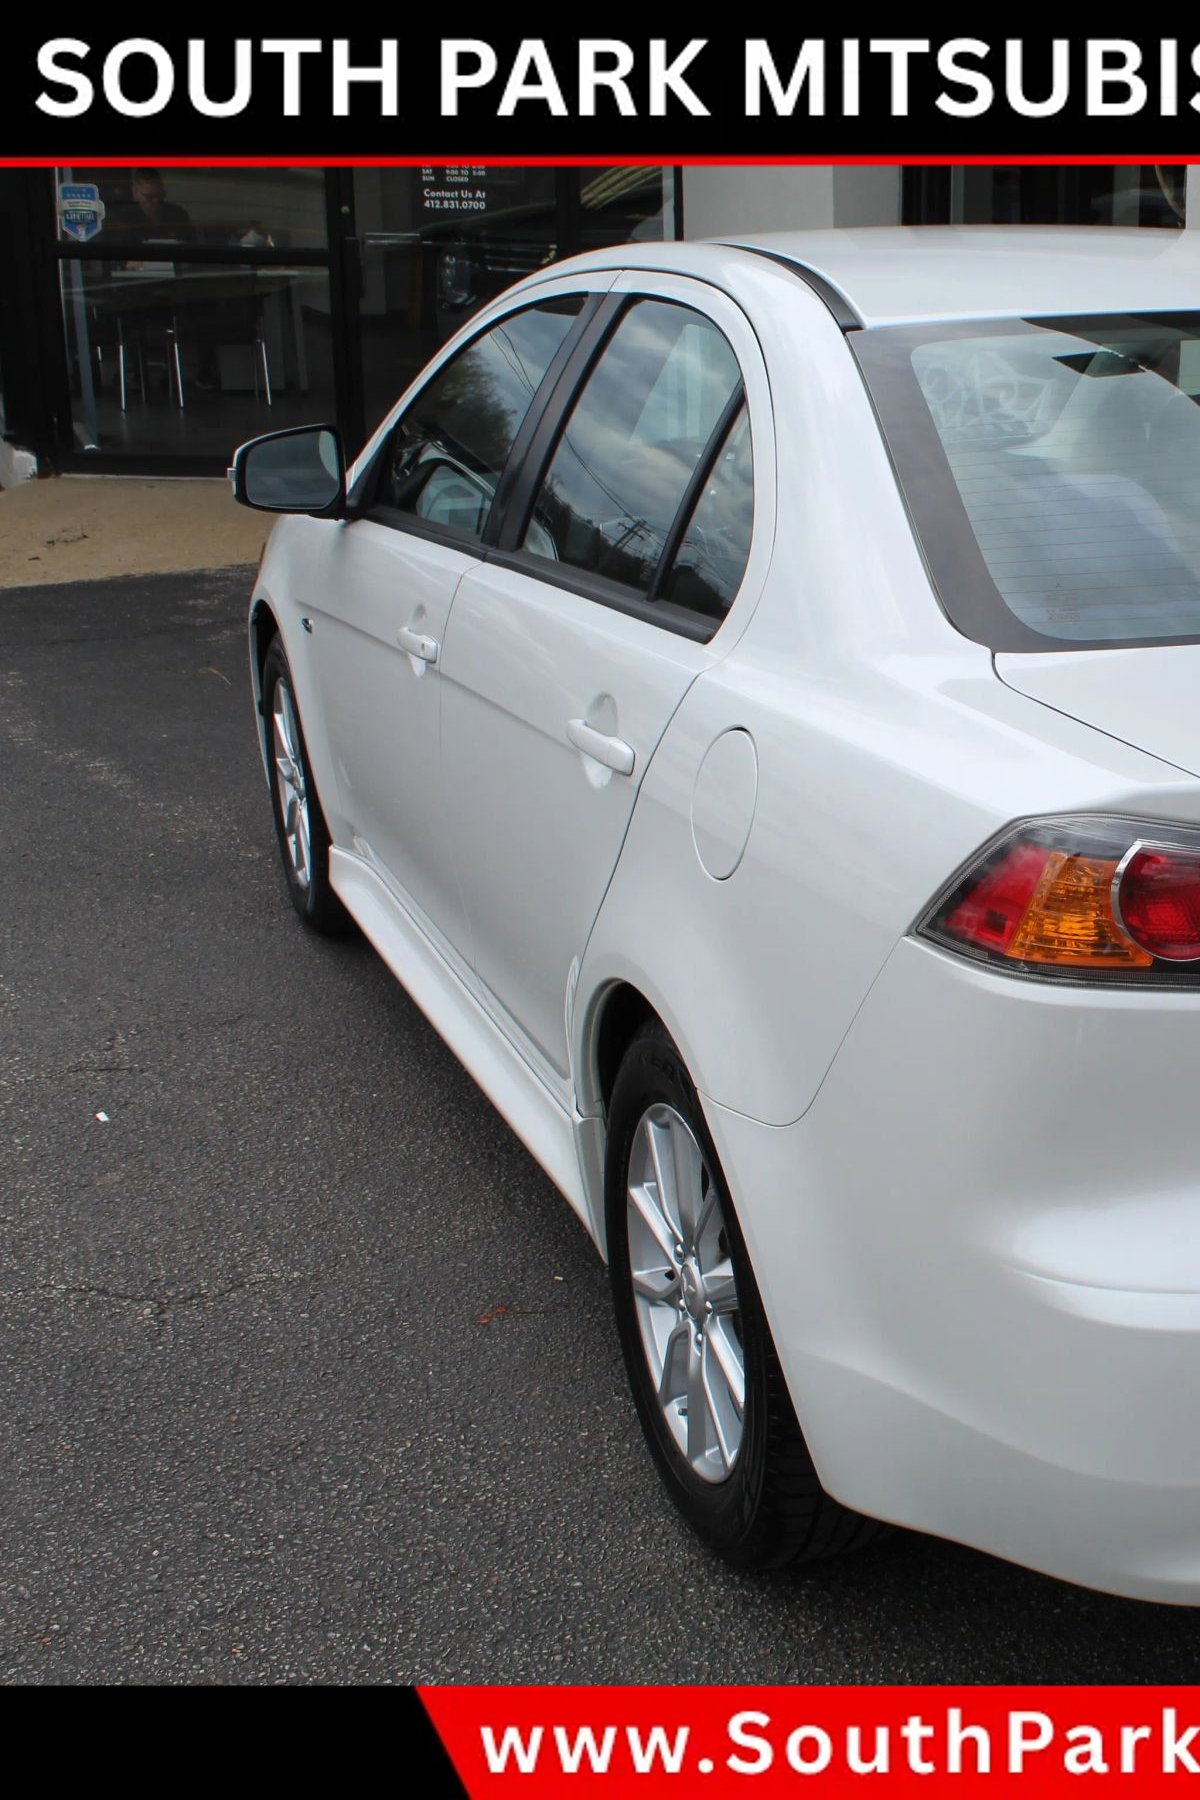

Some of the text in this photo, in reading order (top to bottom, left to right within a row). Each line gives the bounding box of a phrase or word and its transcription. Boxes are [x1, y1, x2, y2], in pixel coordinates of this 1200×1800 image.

[423, 188, 486, 199] Contact Us At
[423, 200, 486, 210] 412.831.0700
